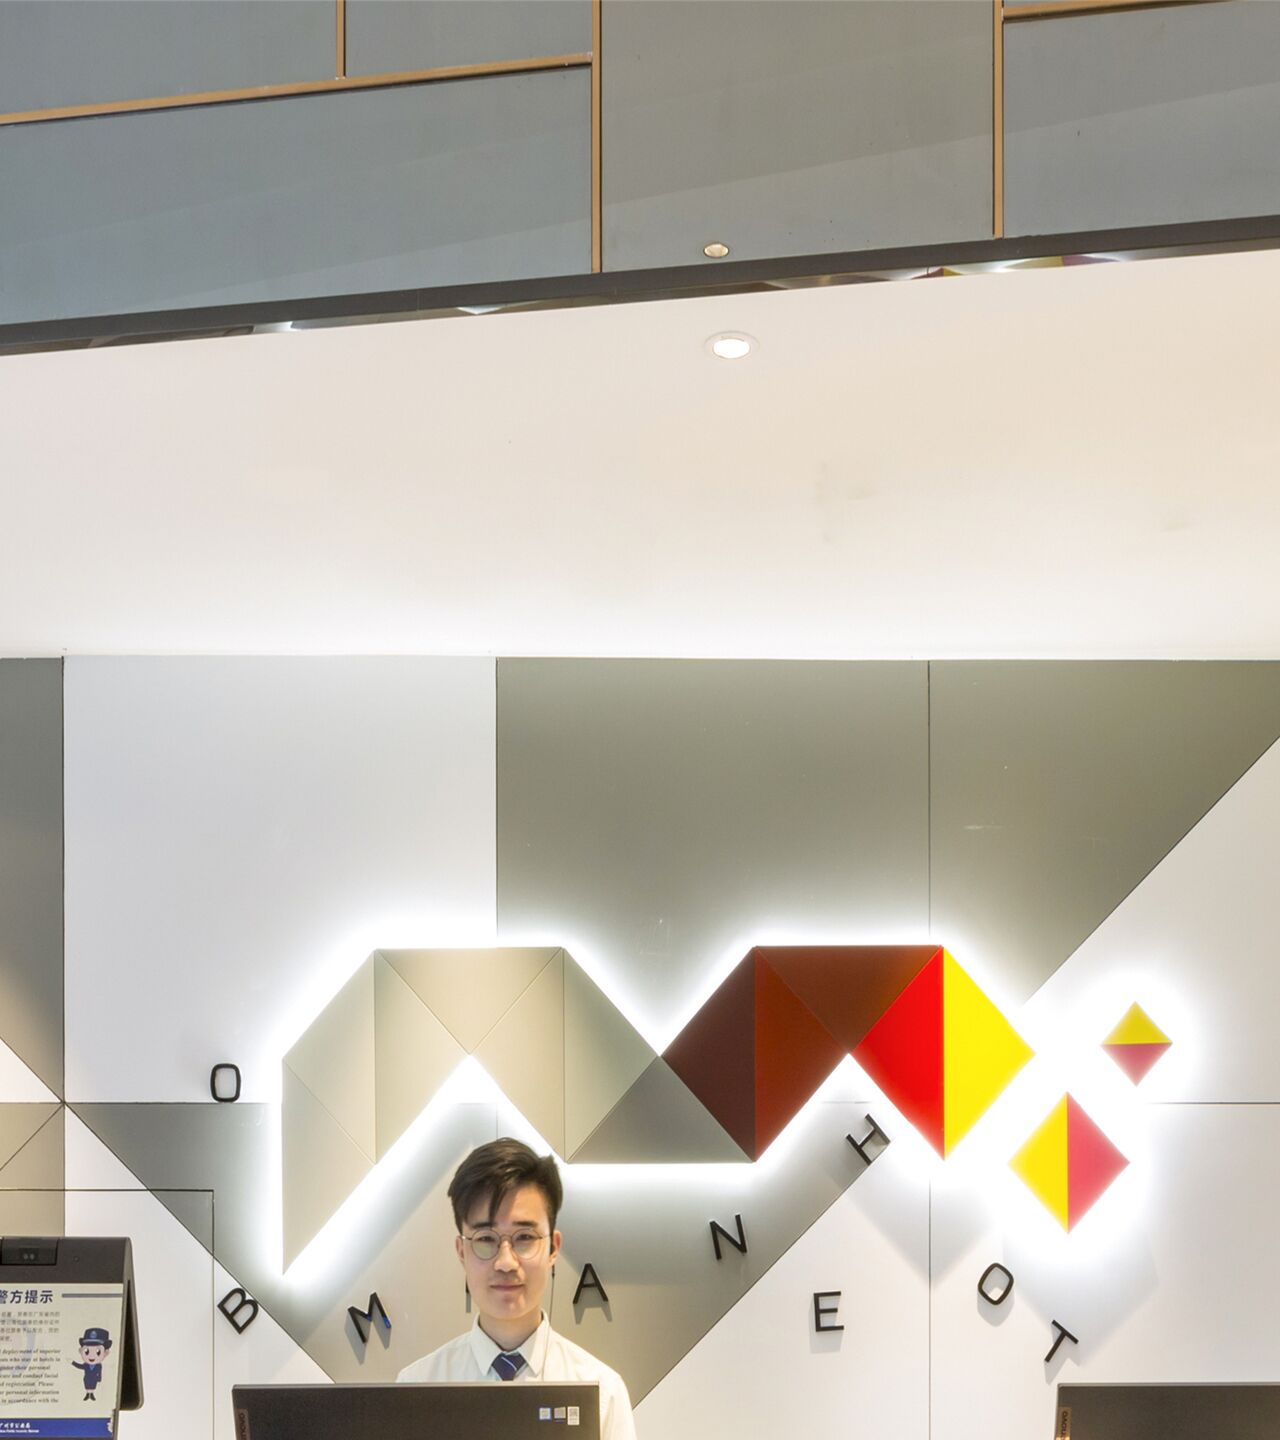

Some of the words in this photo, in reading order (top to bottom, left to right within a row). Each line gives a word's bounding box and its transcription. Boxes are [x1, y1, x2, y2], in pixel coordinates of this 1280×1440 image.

[210, 1063, 241, 1102] O
[846, 1113, 891, 1165] H
[709, 1214, 747, 1260] N
[573, 1263, 608, 1304] A
[977, 1262, 1014, 1305] O
[217, 1287, 259, 1335] B
[348, 1292, 391, 1344] M
[813, 1291, 845, 1332] E
[1044, 1320, 1078, 1362] T
